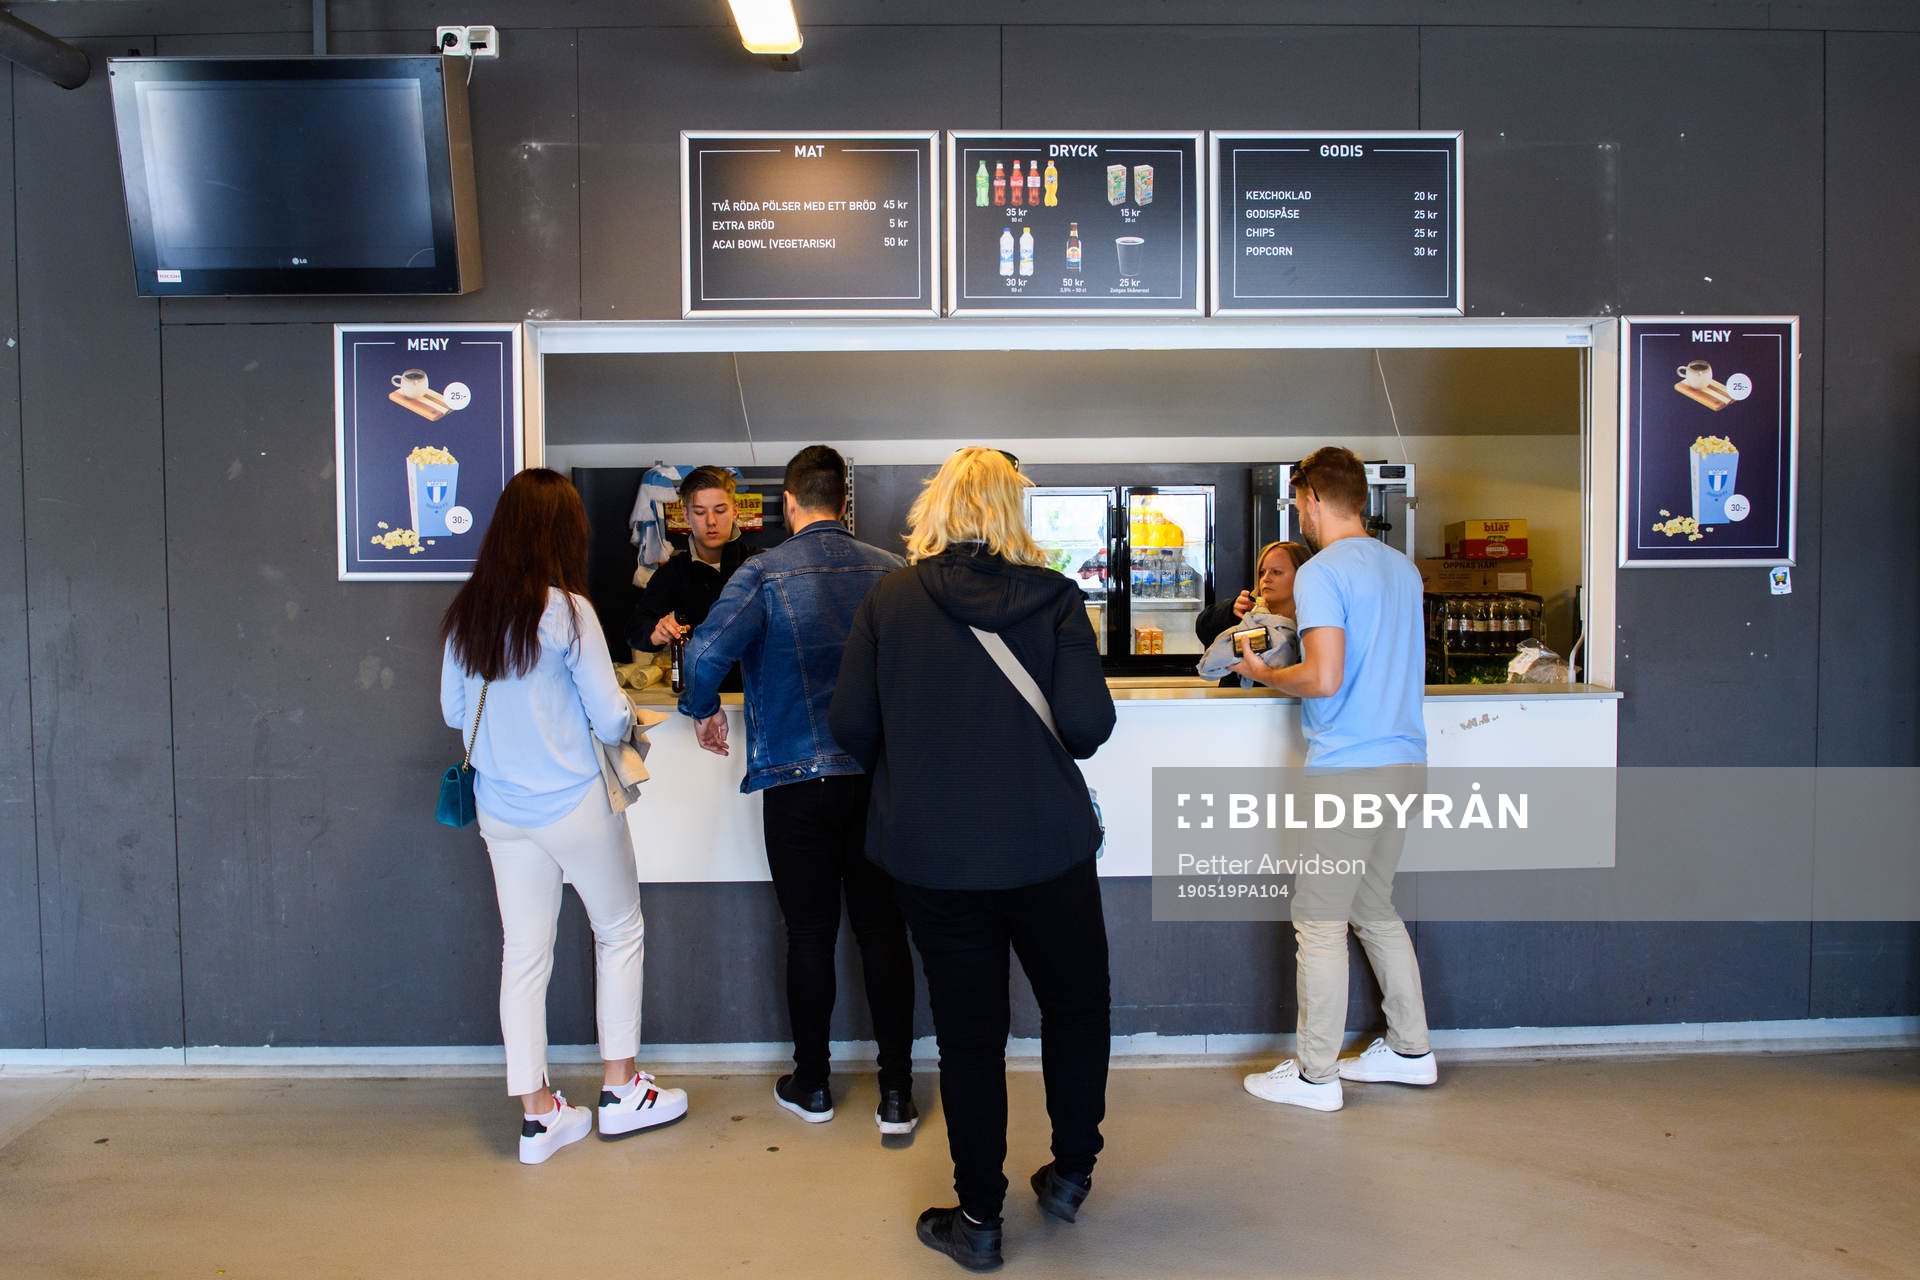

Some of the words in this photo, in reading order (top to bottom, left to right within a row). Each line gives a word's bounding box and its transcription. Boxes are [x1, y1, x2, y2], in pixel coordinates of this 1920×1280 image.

[795, 145, 824, 157] MAT
[1050, 145, 1098, 157] DRYCK
[1320, 145, 1363, 156] GODIS
[1246, 191, 1311, 199] KEXCHOKLAD
[1415, 192, 1425, 200] 20
[1428, 192, 1437, 200] kr
[712, 200, 730, 211] TVÅ
[733, 200, 760, 211] RÖDA
[763, 200, 800, 211] PÖLSER
[804, 202, 825, 210] MED
[828, 202, 846, 210] ETT
[849, 200, 876, 210] BRÖD
[884, 200, 894, 208] 45
[898, 200, 908, 208] kr
[1007, 208, 1016, 216] 35
[1019, 208, 1027, 216] kr
[1246, 207, 1299, 218] GODISPÅSE
[1415, 210, 1425, 219] 25
[1428, 211, 1438, 219] kr
[713, 221, 745, 230] EXTRA
[748, 219, 774, 229] BRÖD
[890, 219, 895, 227] 5
[898, 219, 908, 227] kr
[1246, 228, 1274, 237] CHIPS
[1415, 229, 1425, 237] 25
[1428, 229, 1437, 237] kr
[713, 240, 734, 249] ACAI
[738, 240, 767, 248] BOWL
[770, 238, 835, 248] (VEGETARISK)
[884, 238, 895, 246] 50
[898, 238, 908, 246] kr
[1246, 247, 1292, 255] POPCORN
[1414, 247, 1425, 256] 30
[1428, 248, 1437, 256] kr
[1006, 278, 1016, 286] 30
[1063, 278, 1076, 286] 50
[1692, 330, 1731, 342] MENY
[408, 338, 449, 350] MENY
[451, 392, 466, 400] 25:-
[453, 516, 468, 524] 30:-
[1484, 522, 1510, 532] bilar
